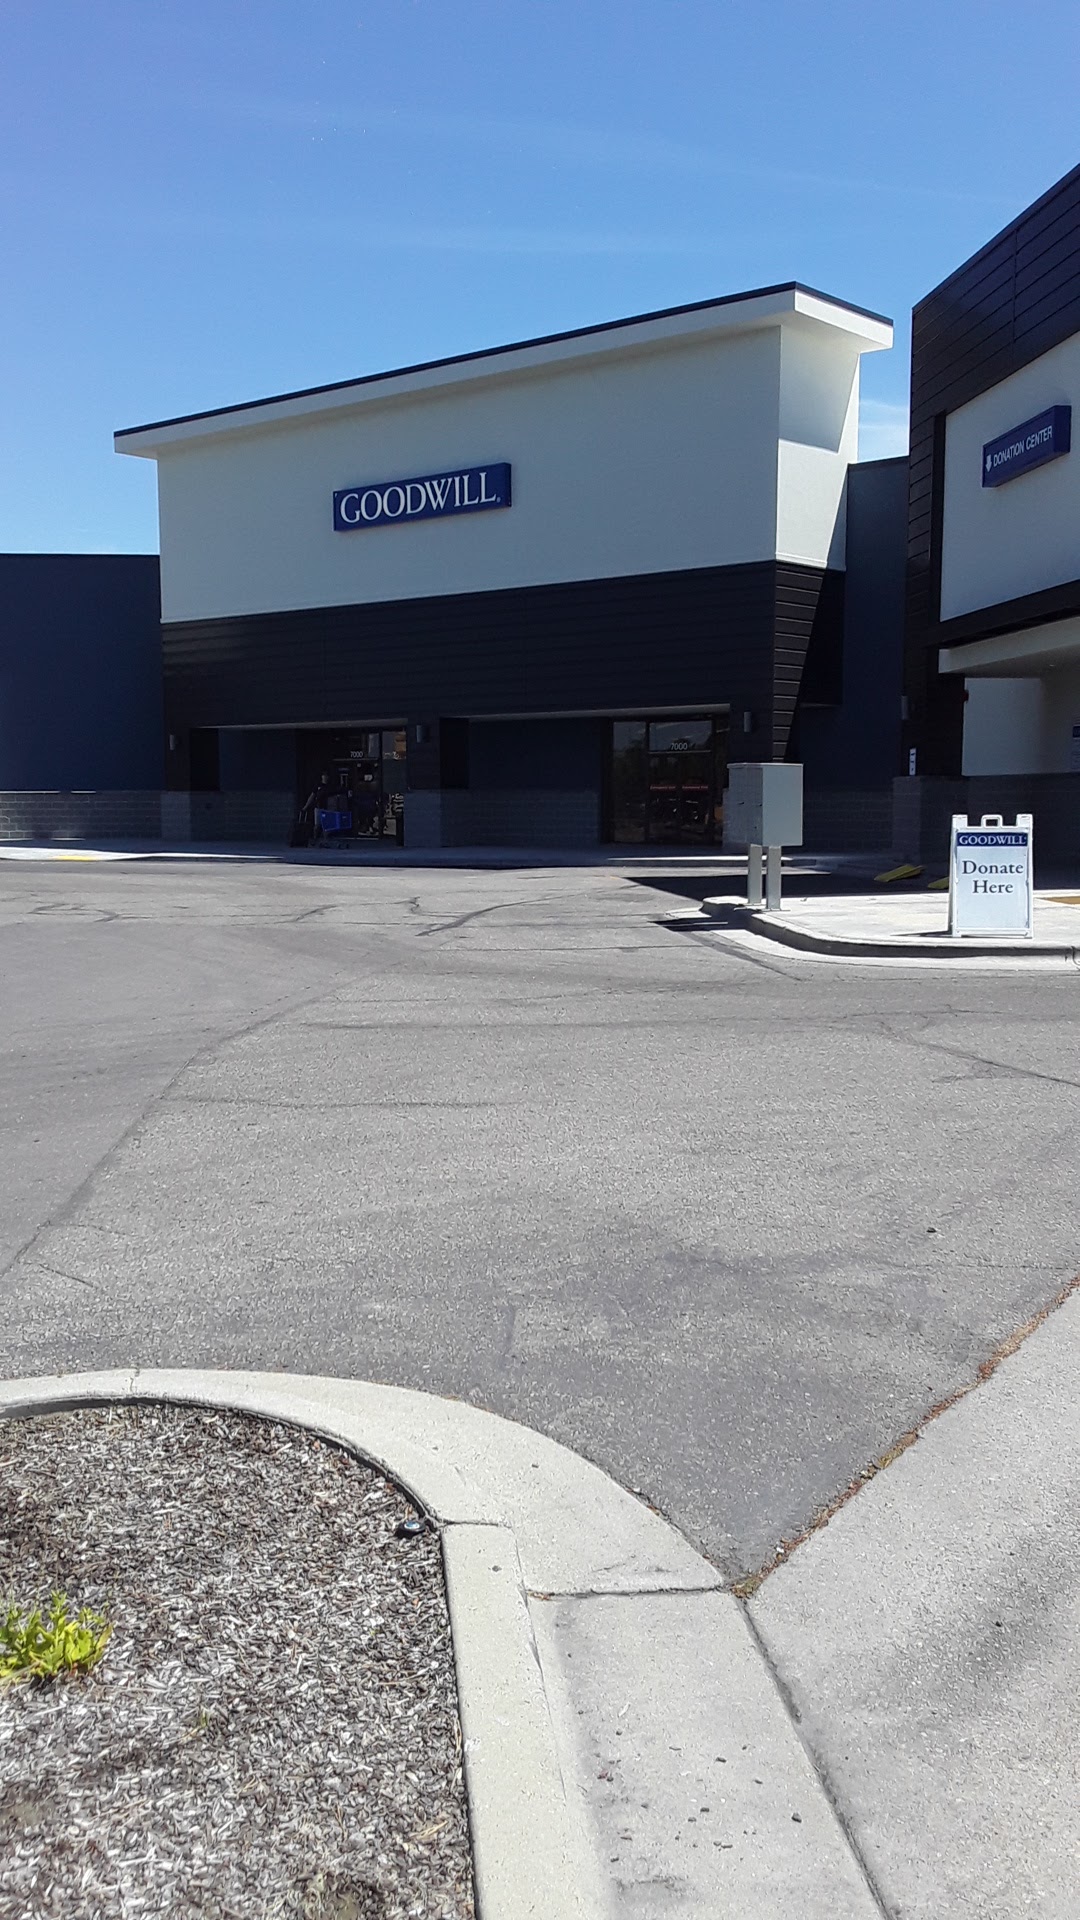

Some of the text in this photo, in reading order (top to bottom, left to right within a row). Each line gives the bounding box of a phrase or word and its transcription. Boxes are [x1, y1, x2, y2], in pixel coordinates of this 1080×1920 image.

[993, 425, 1053, 468] DONATION CENTER
[340, 472, 499, 523] GOODWILL
[670, 742, 688, 750] 7000
[959, 835, 1025, 845] GOODWILL
[961, 860, 1024, 875] Donate
[972, 879, 1014, 894] Here
